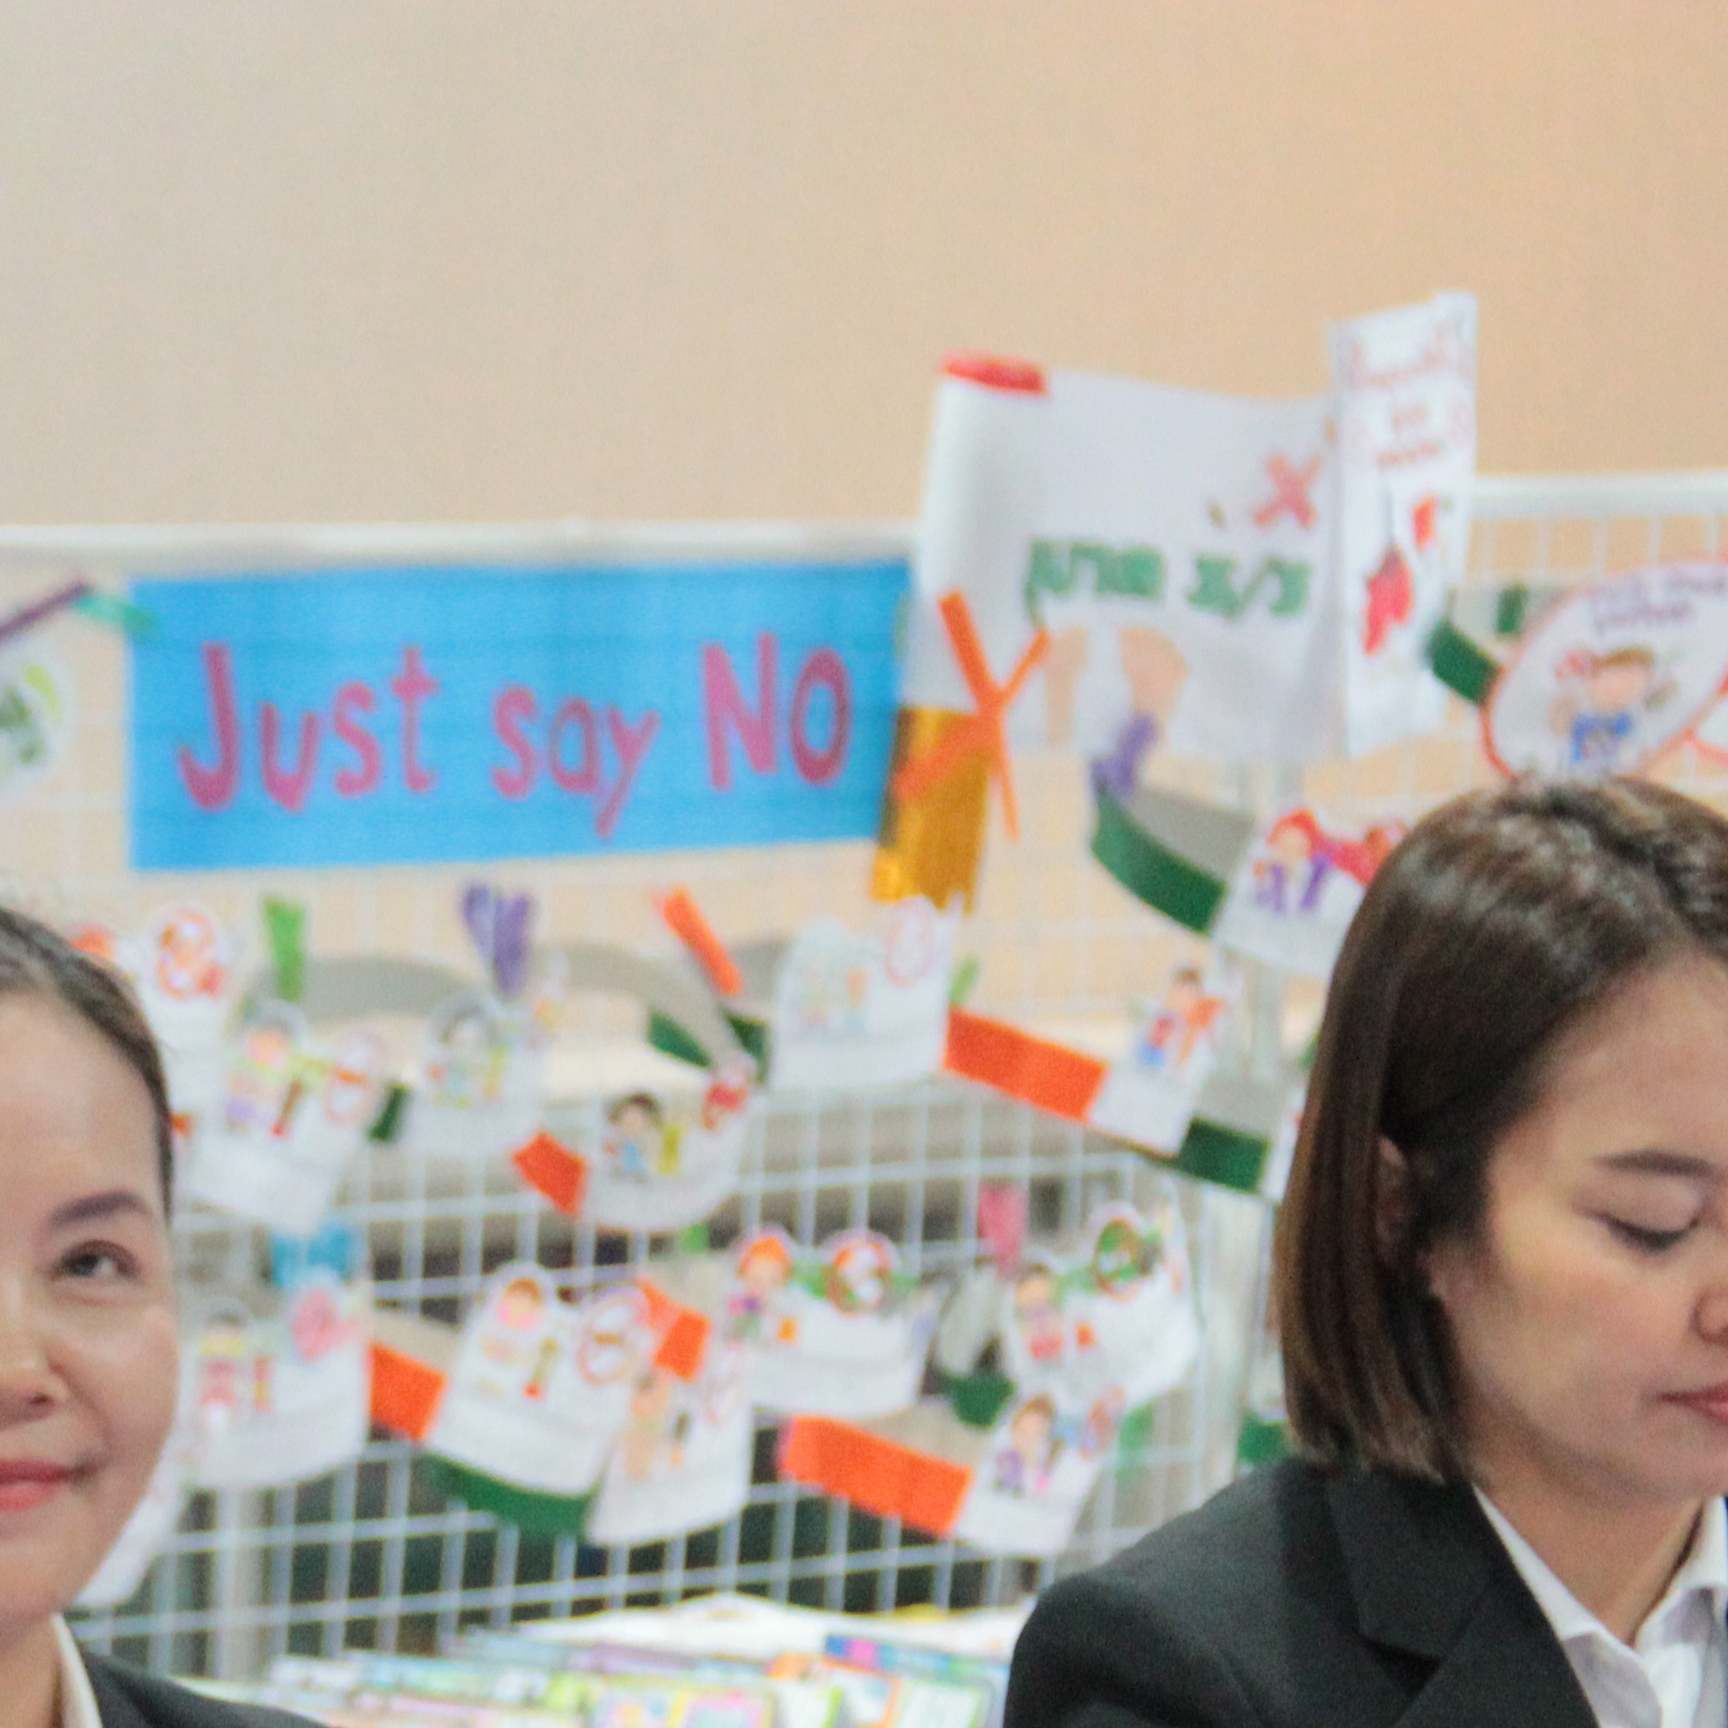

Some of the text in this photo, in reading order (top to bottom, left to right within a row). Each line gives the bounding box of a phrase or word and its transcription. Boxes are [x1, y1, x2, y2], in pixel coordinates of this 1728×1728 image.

[175, 641, 440, 812] Just
[489, 681, 661, 839] say
[698, 630, 854, 793] NO
